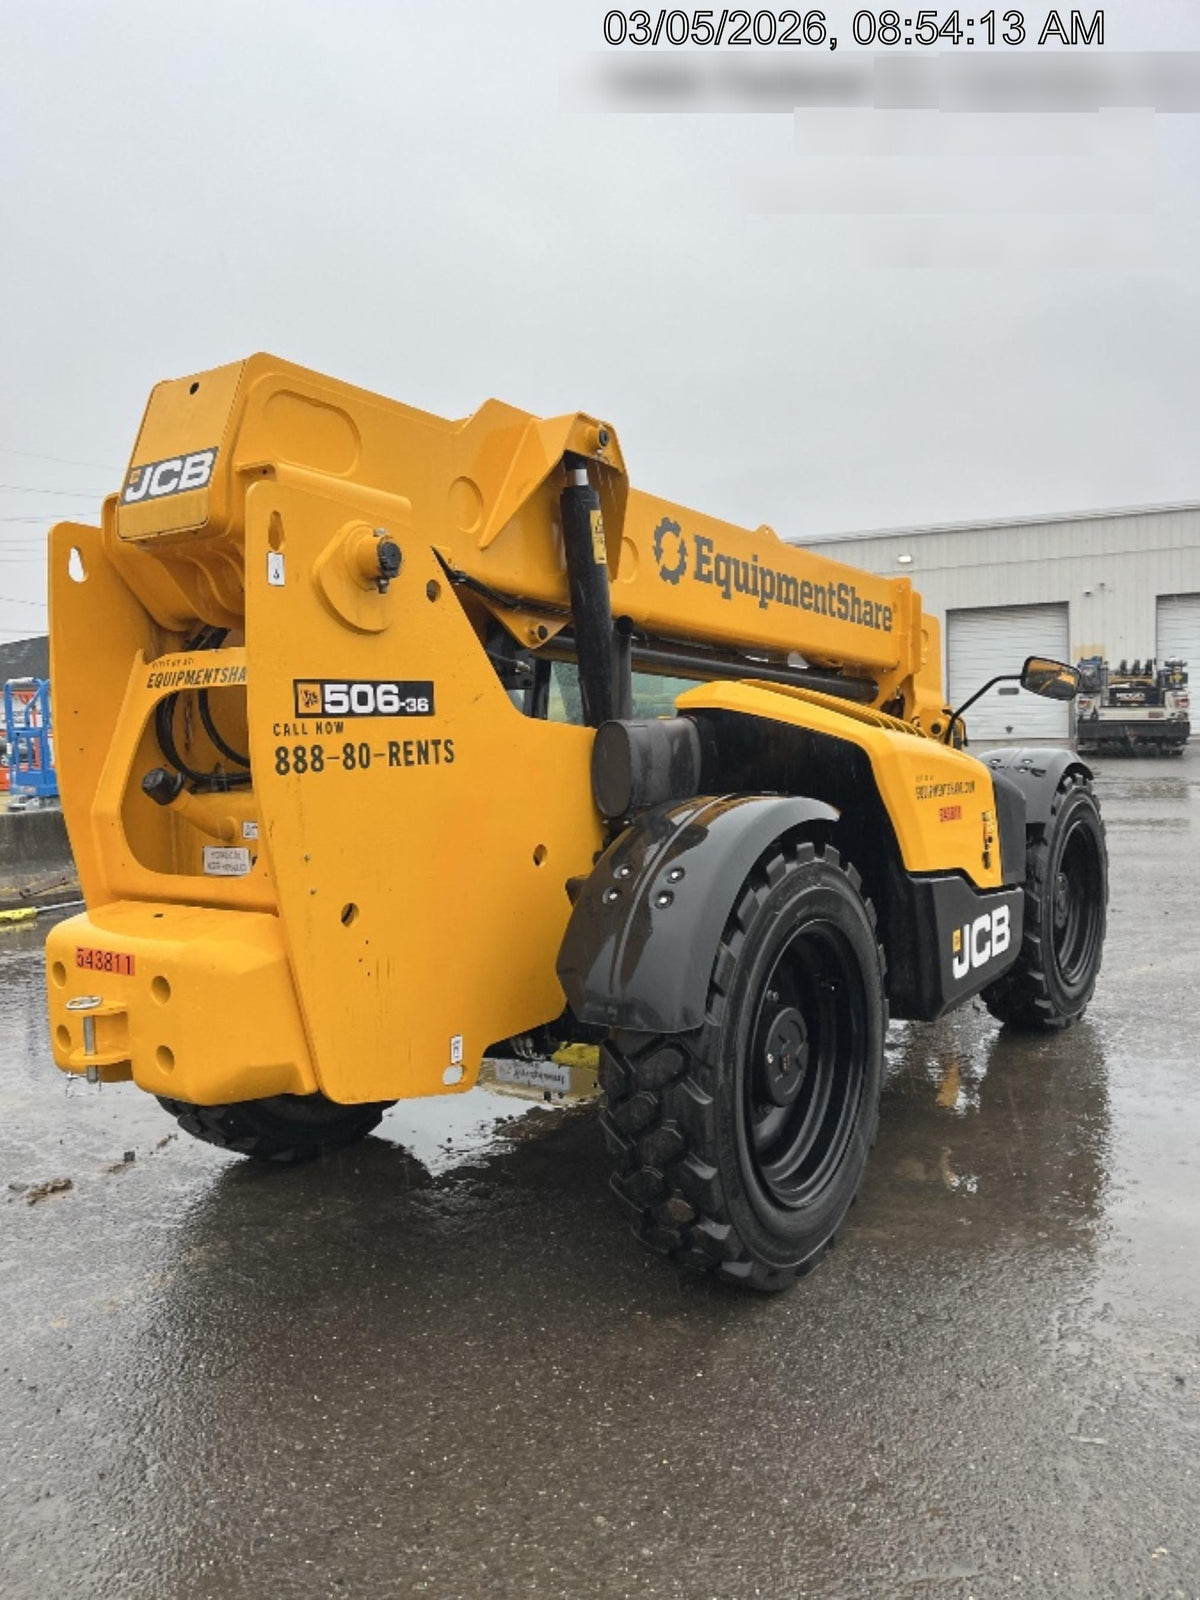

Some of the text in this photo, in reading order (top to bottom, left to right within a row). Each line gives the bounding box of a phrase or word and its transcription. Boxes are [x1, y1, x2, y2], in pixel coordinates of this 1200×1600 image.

[125, 451, 214, 503] JCB
[693, 534, 894, 633] EquipmentShare
[323, 683, 430, 715] 506-36
[273, 721, 344, 737] CALL NOW
[274, 738, 456, 777] 888-80-RENTS
[76, 947, 133, 976] 543811
[952, 904, 1011, 980] JCB
